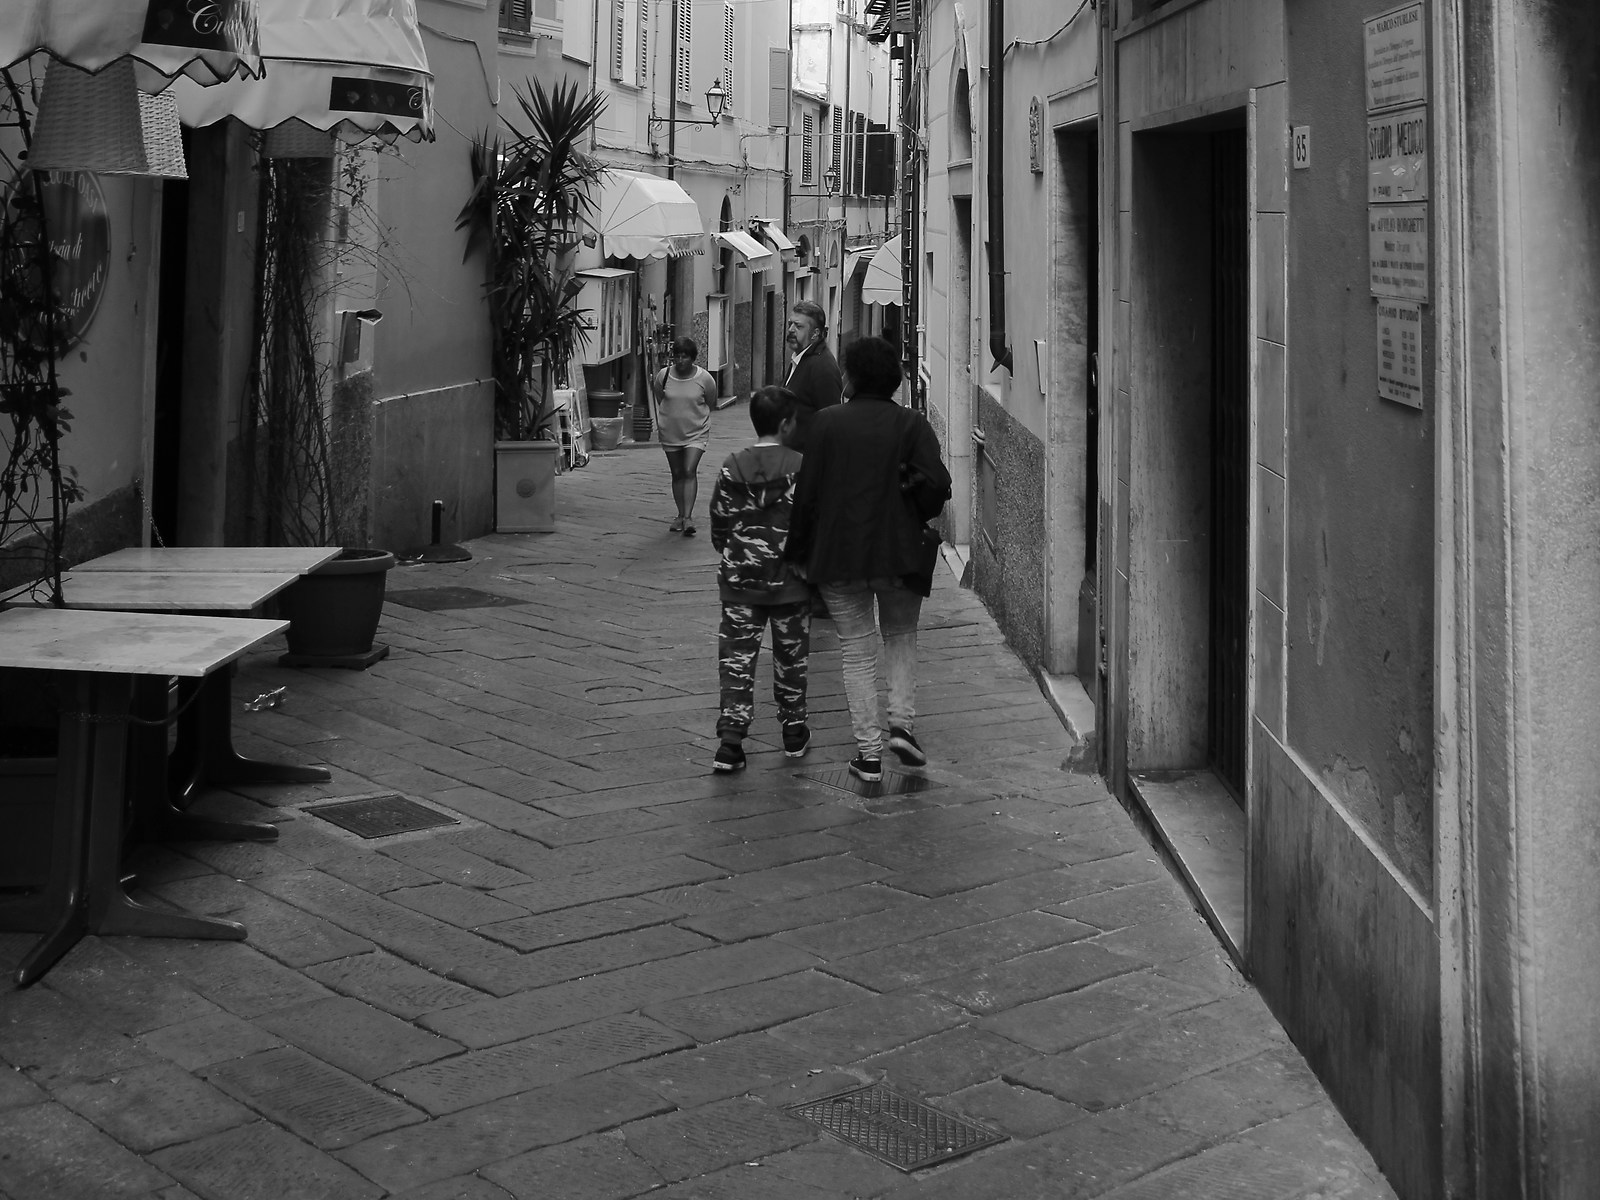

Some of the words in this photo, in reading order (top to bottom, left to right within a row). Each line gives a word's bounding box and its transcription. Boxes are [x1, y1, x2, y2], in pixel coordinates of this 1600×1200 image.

[1296, 133, 1307, 164] 85
[1369, 124, 1393, 160] STUDIO
[1396, 118, 1424, 157] MEDICO
